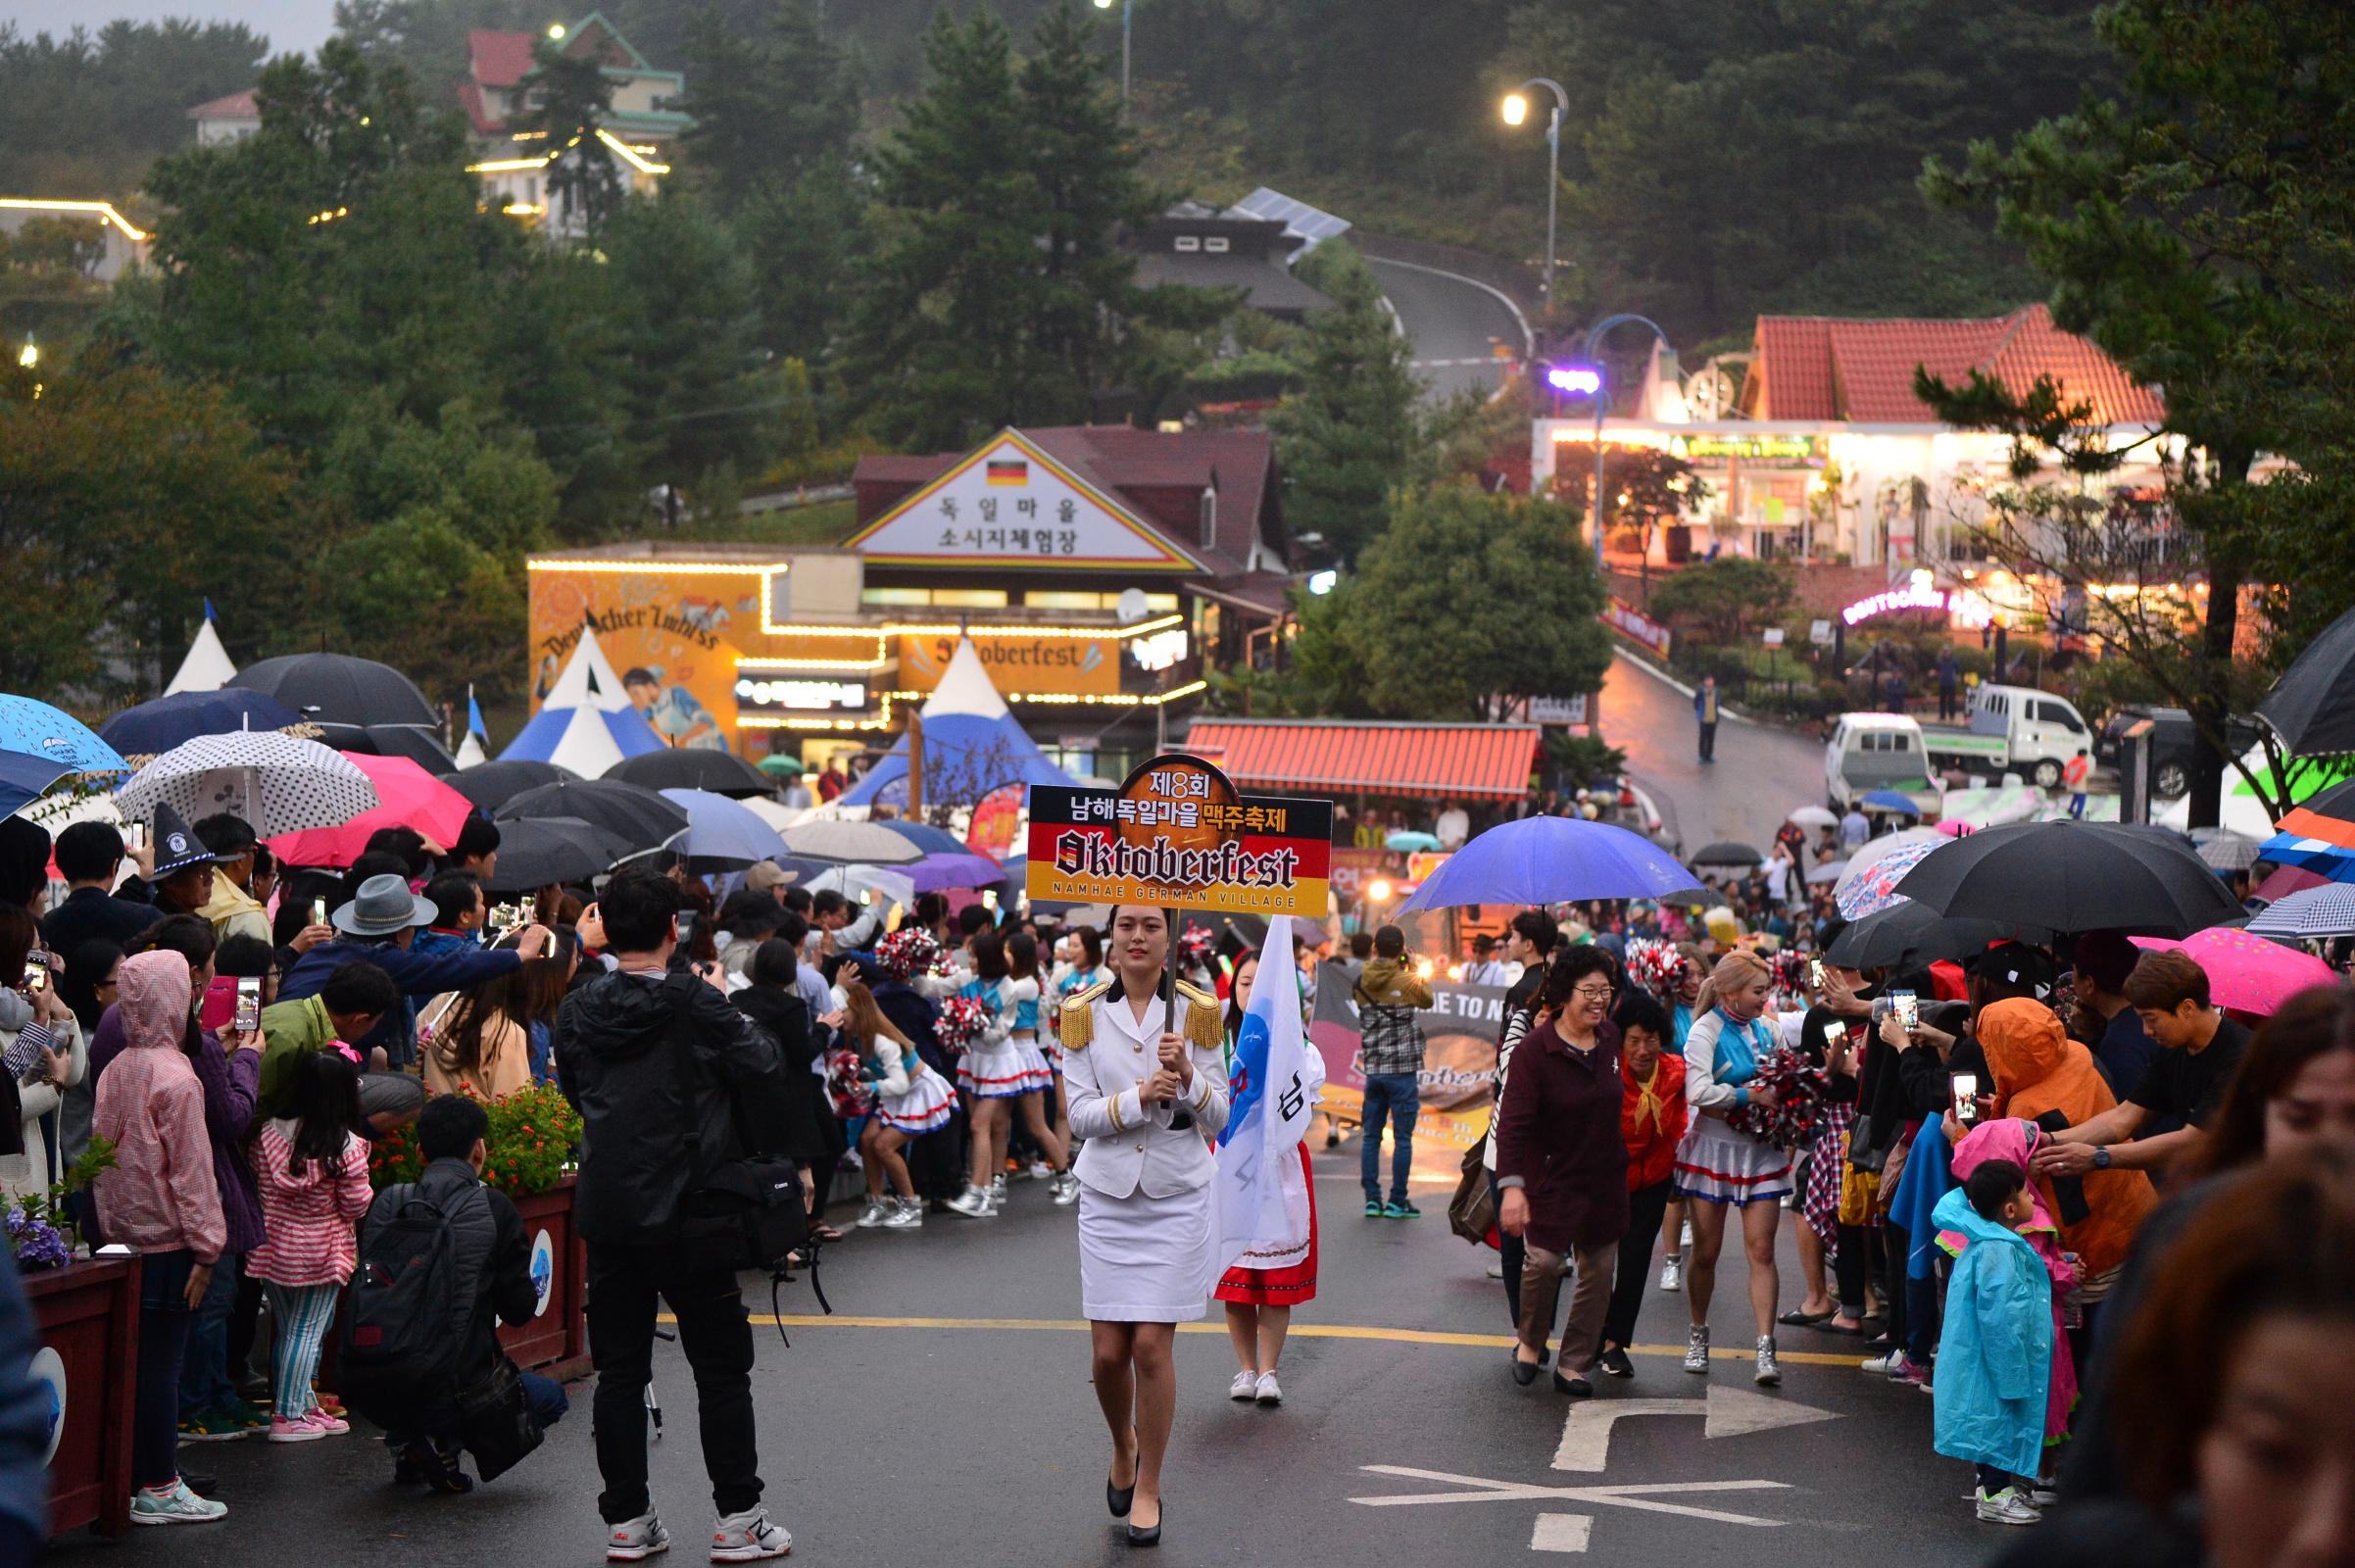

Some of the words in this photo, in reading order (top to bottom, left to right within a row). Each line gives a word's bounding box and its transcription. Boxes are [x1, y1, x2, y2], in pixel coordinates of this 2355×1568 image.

[939, 497, 1077, 523] 독일마을
[938, 529, 1077, 554] 소시지체험장
[936, 637, 1080, 668] Ooberfest
[1150, 771, 1209, 799] 제8회
[1071, 797, 1200, 828] 남해독일마을
[1202, 805, 1287, 832] 맥주축제
[1055, 829, 1300, 891] Oktoberfest
[1053, 881, 1125, 898] NAMHAE
[1136, 886, 1207, 903] GERMAN
[1220, 892, 1296, 907] VILLAGE
[1456, 993, 1484, 1017] TO
